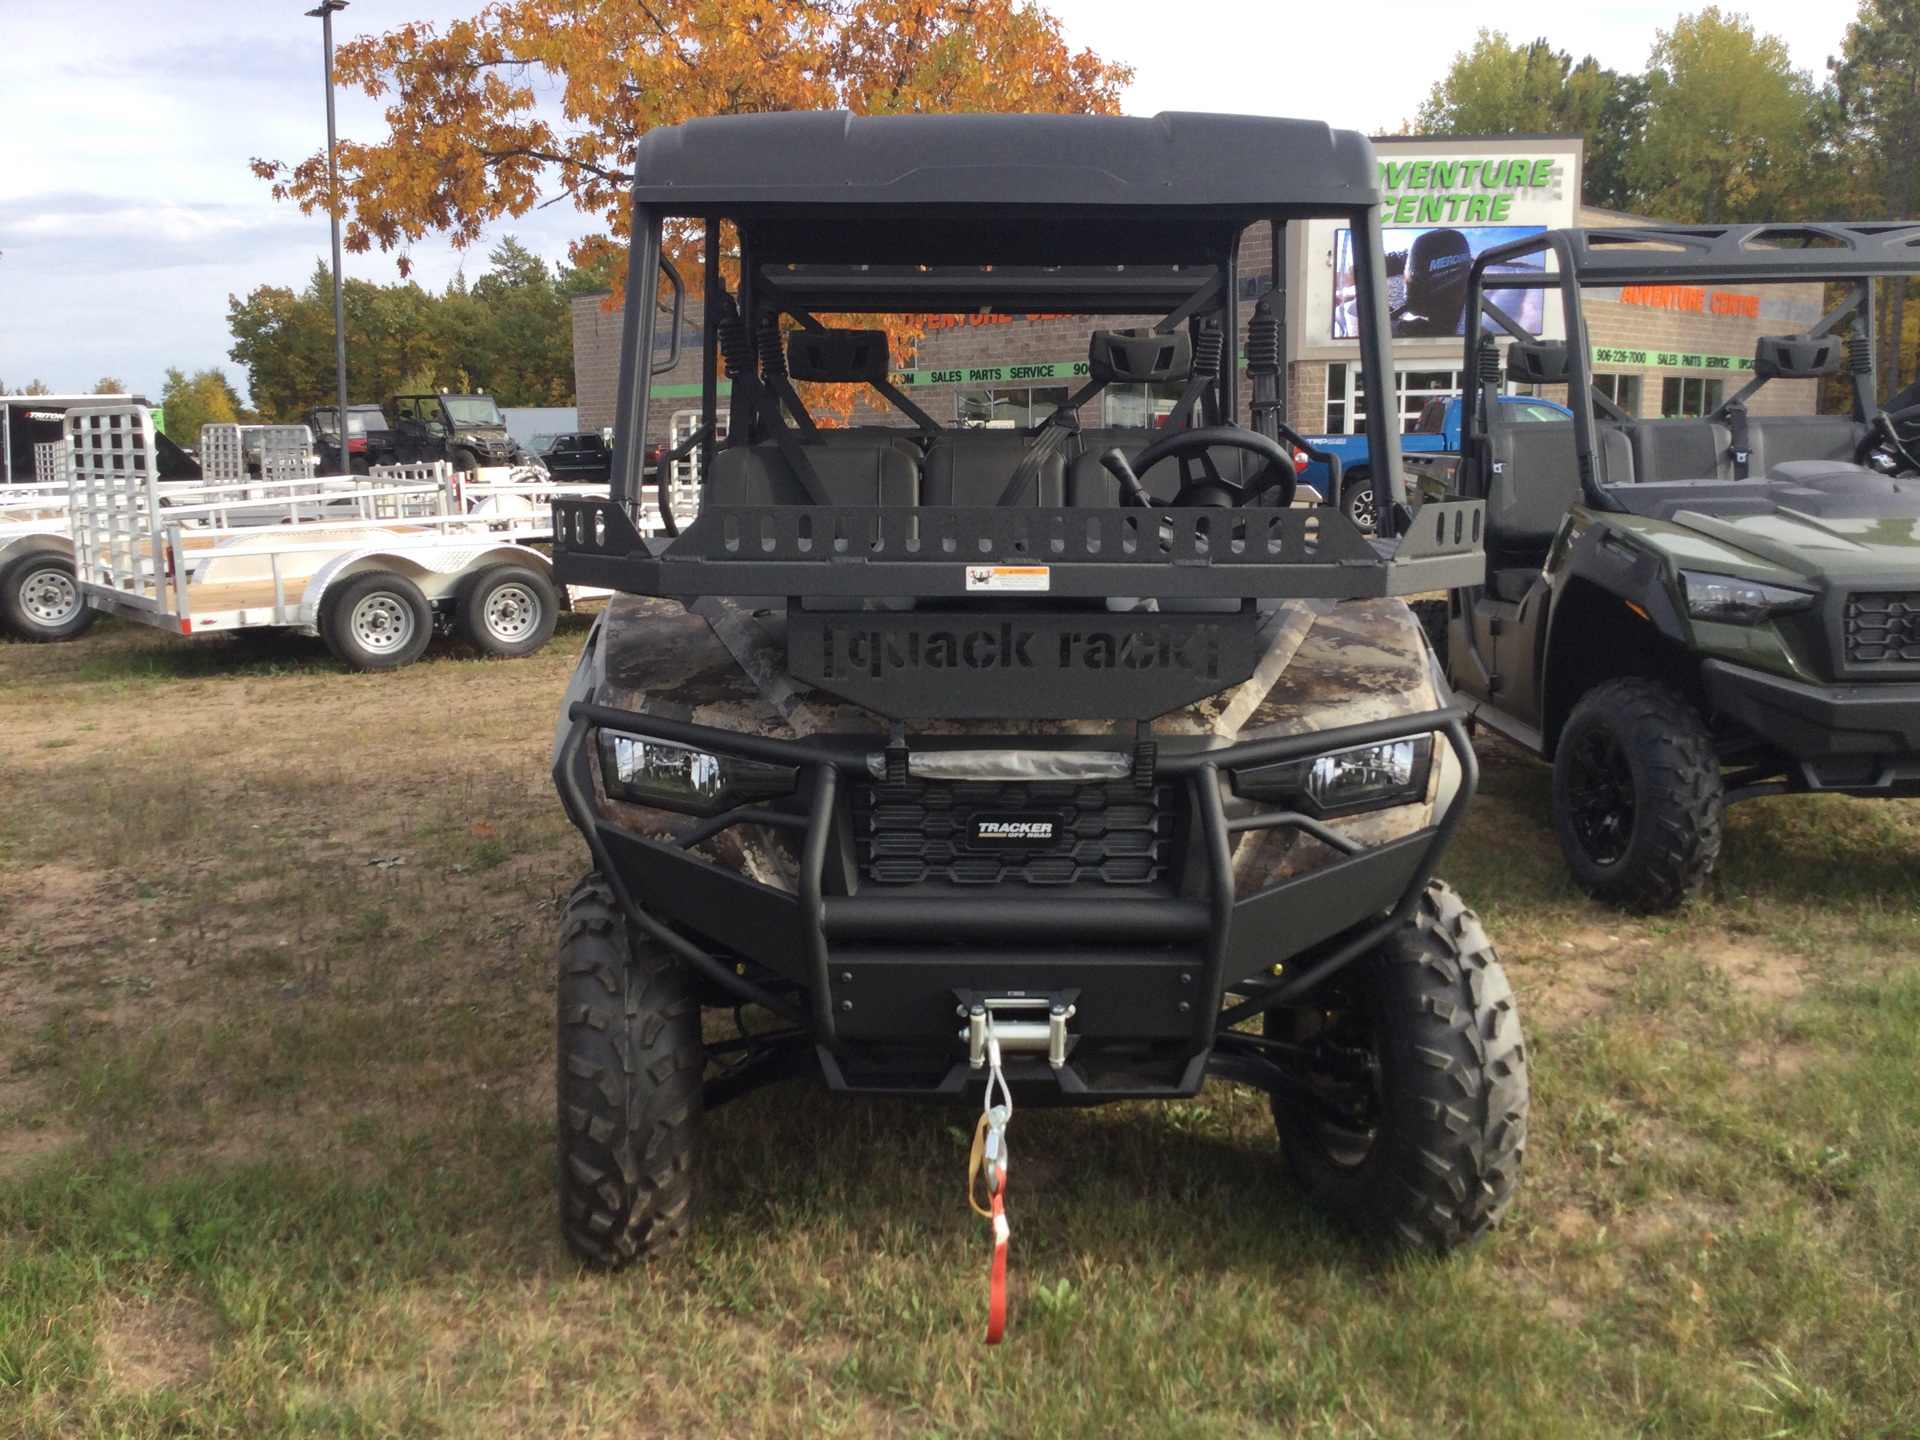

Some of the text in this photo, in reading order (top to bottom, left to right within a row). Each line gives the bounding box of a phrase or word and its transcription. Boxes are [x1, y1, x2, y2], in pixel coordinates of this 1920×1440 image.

[1379, 194, 1514, 223] CENTRE
[1620, 285, 1759, 318] ADVENTURE CENTRE
[1596, 349, 1646, 364] 906-226-7000
[1657, 353, 1678, 366] SALES
[1682, 355, 1701, 368] PARTS
[1705, 357, 1730, 369] SERVICE
[931, 370, 961, 383] SALES
[969, 368, 1001, 381] PARTS
[1010, 365, 1054, 378] SERVICE
[30, 411, 66, 420] TRITON
[978, 823, 1053, 832] TRACKER
